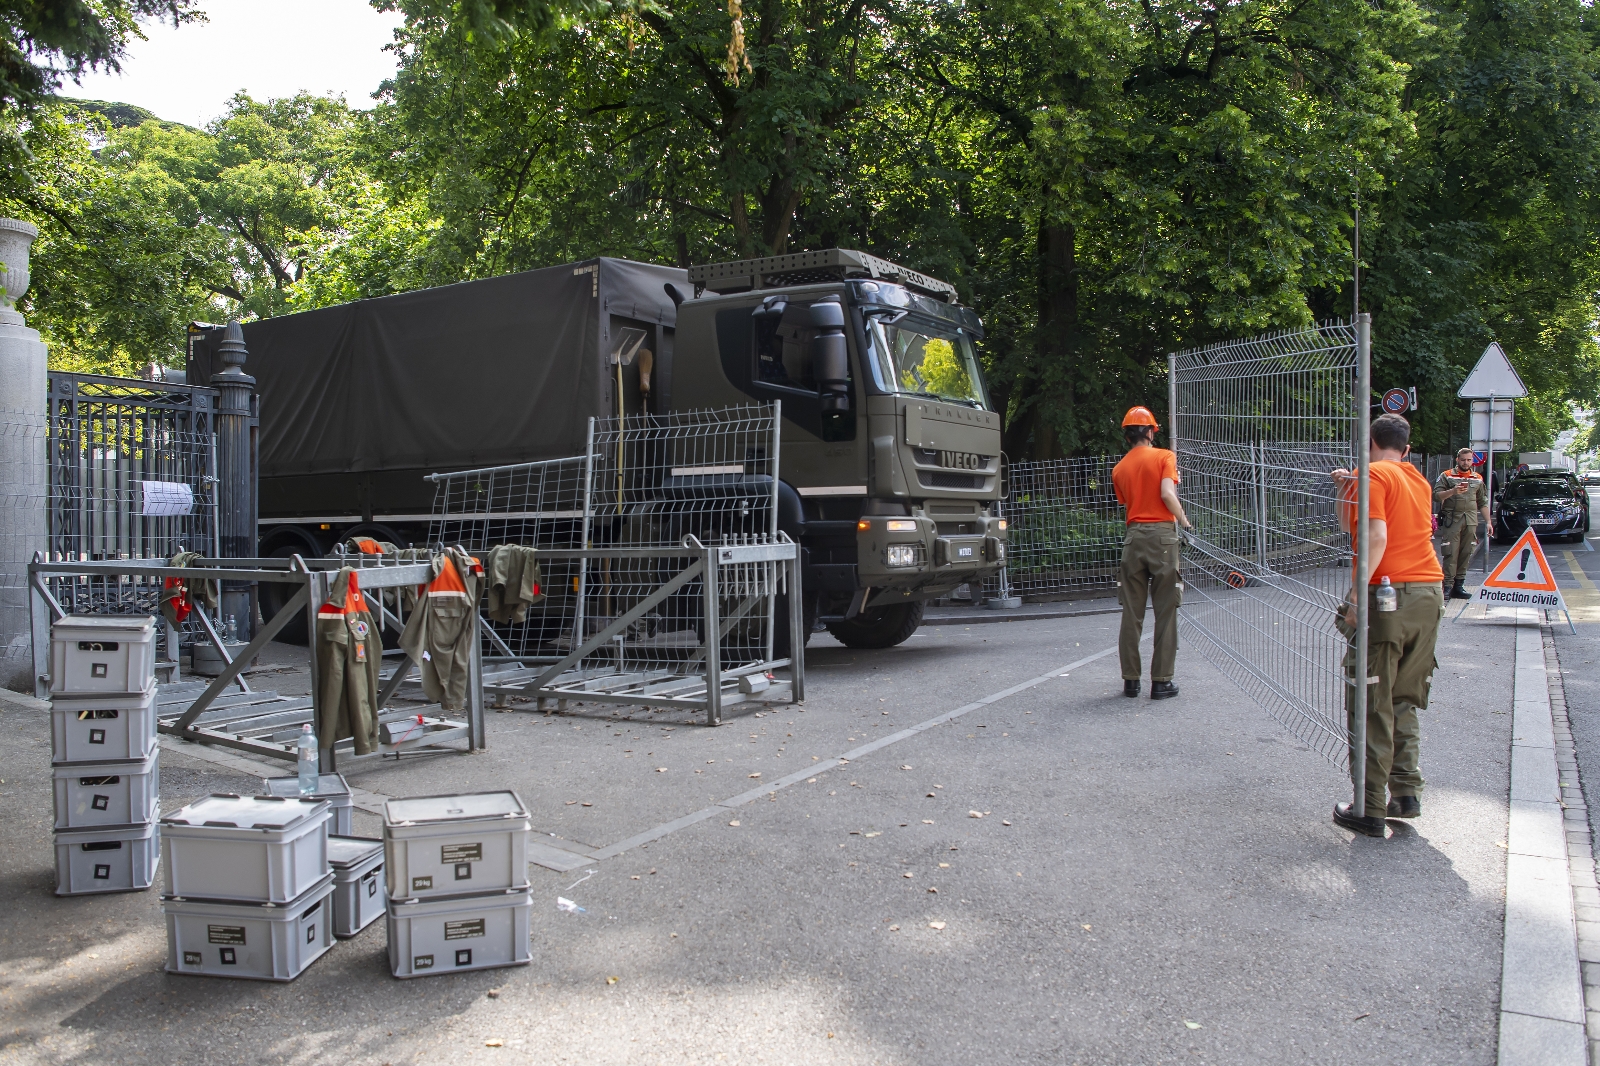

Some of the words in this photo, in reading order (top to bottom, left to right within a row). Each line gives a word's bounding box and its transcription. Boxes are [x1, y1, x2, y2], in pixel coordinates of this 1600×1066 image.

[897, 267, 925, 286] IVECO
[924, 404, 990, 424] TRAKKER
[941, 450, 979, 470] IVECO
[1480, 589, 1529, 604] Protection
[1532, 594, 1558, 606] civile
